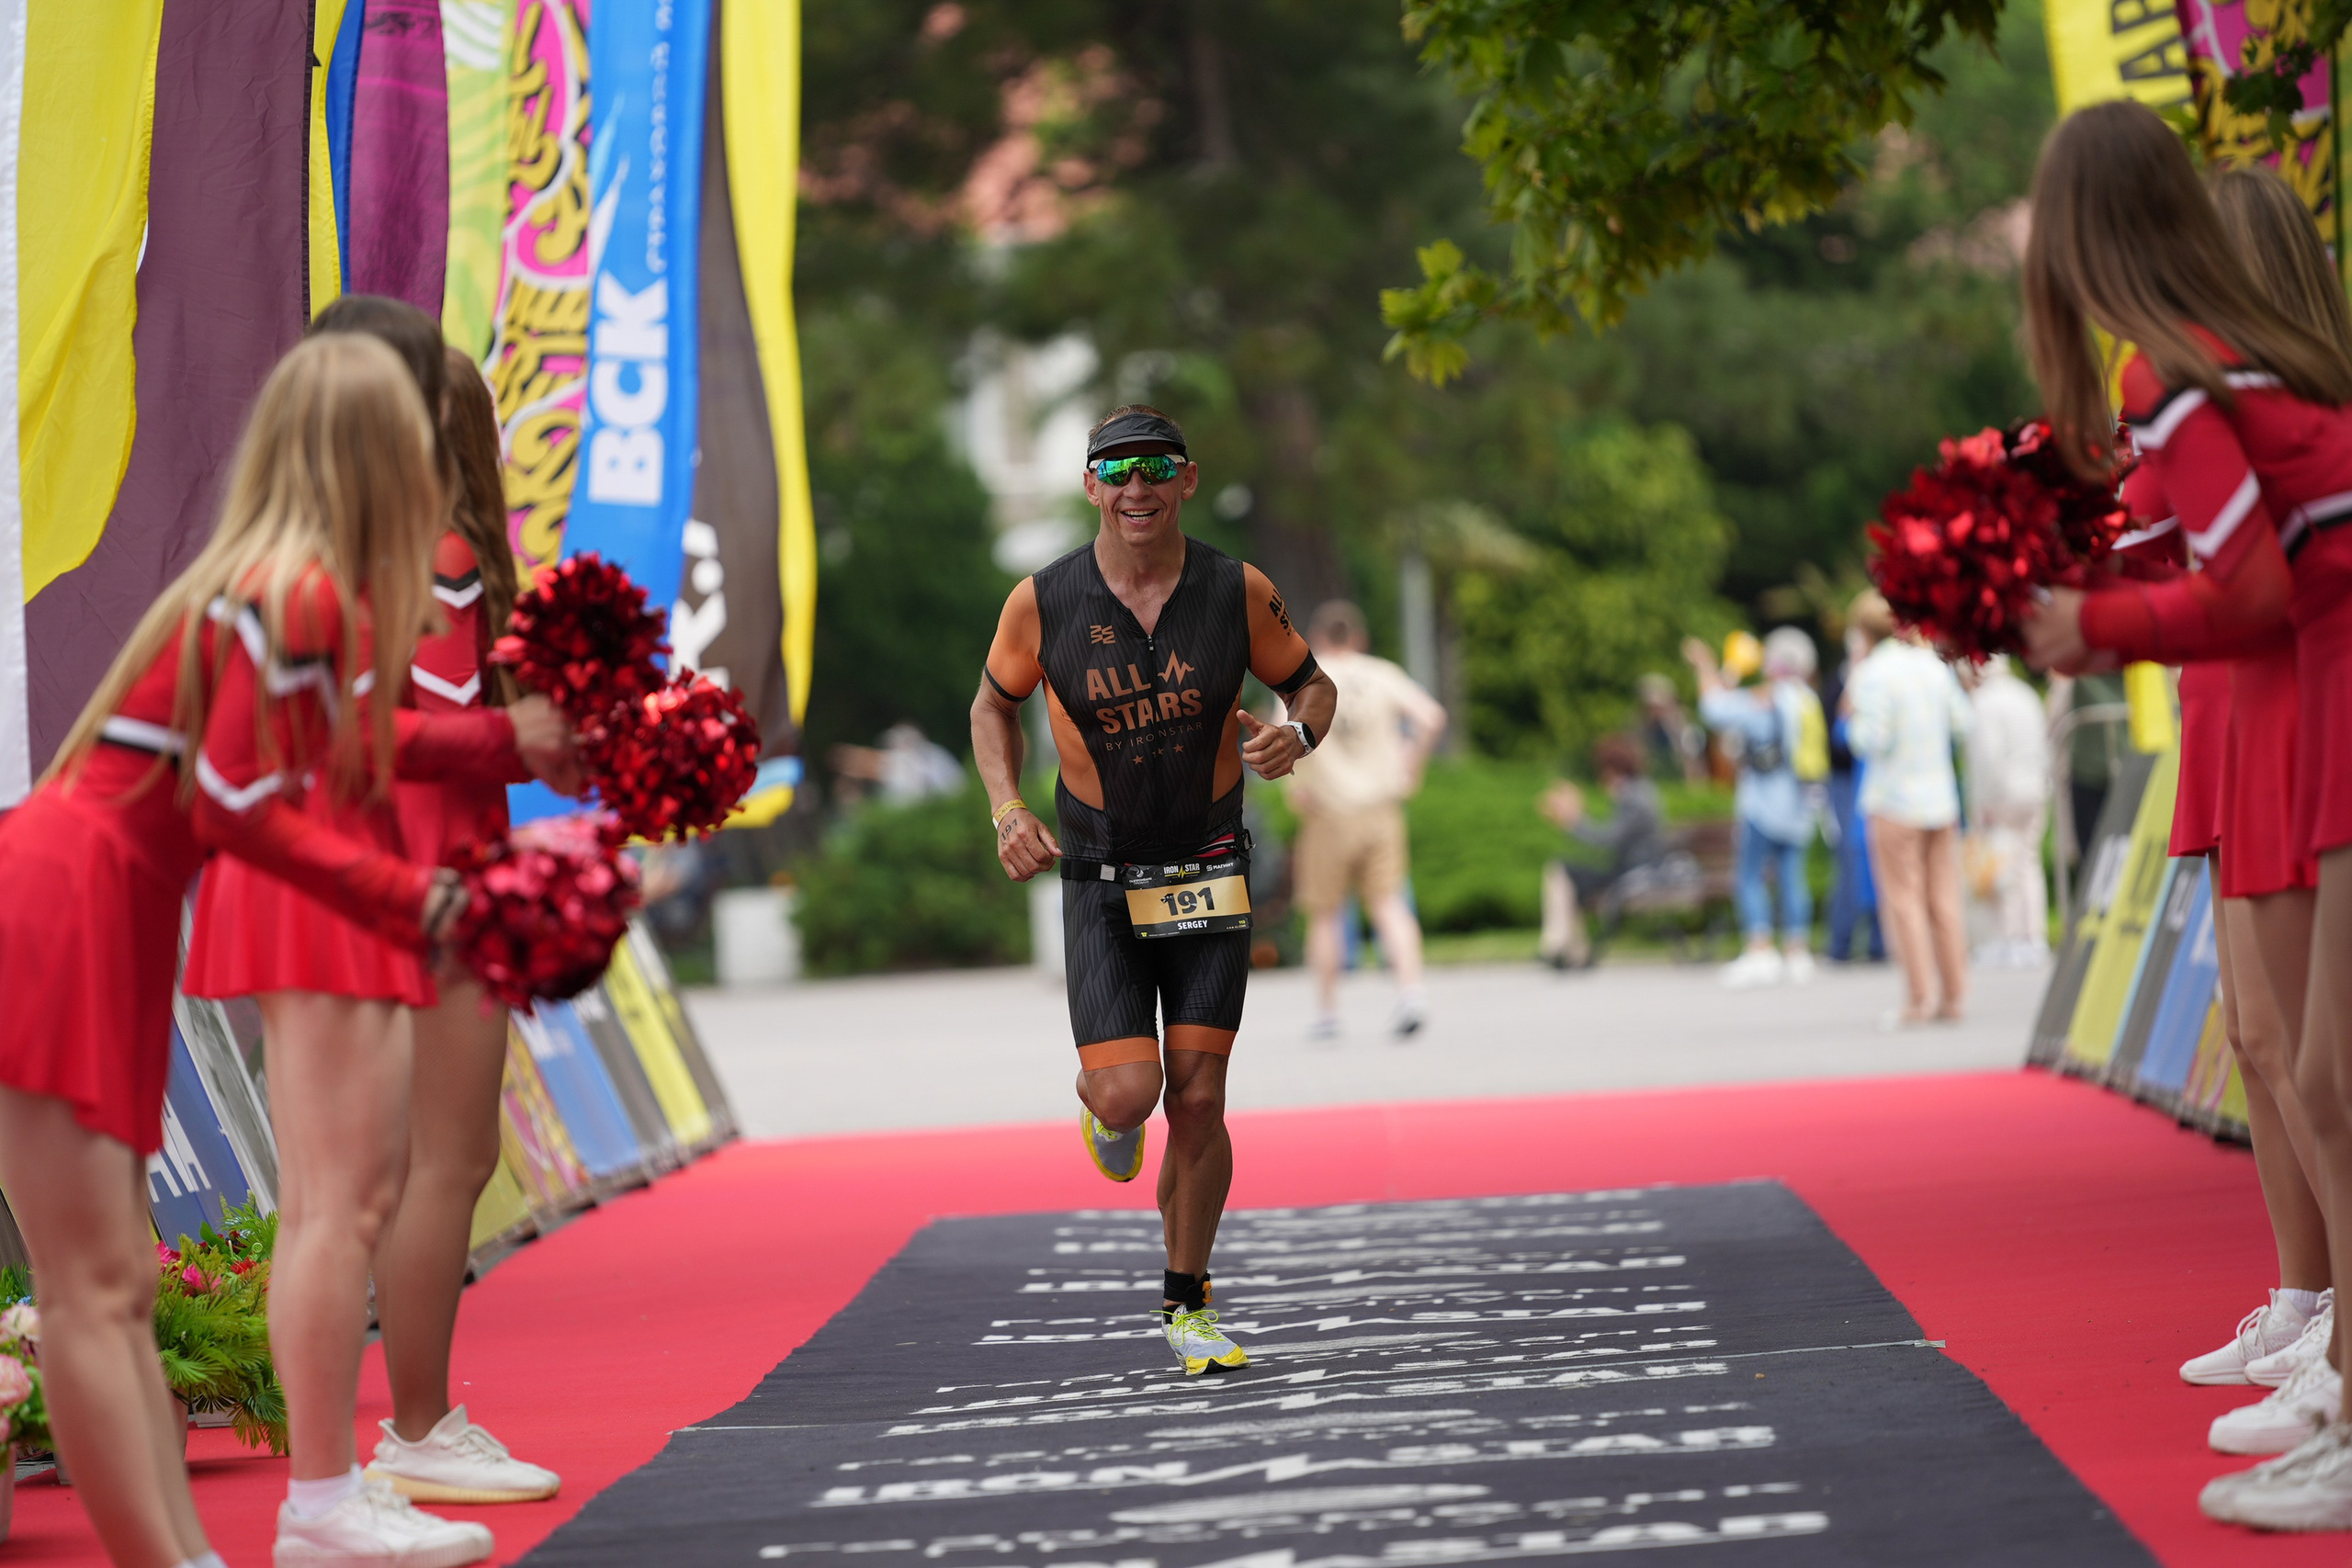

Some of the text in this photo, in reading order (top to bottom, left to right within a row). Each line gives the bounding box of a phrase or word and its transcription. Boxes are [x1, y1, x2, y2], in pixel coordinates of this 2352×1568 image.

[587, 269, 669, 506] ВСК
[1086, 663, 1152, 701] ALL
[1095, 689, 1204, 734] STARS
[1105, 722, 1204, 751] BY IRONSTAR
[1163, 863, 1200, 874] IRON STAR
[1160, 886, 1215, 917] 191
[1177, 919, 1208, 931] SERGEY
